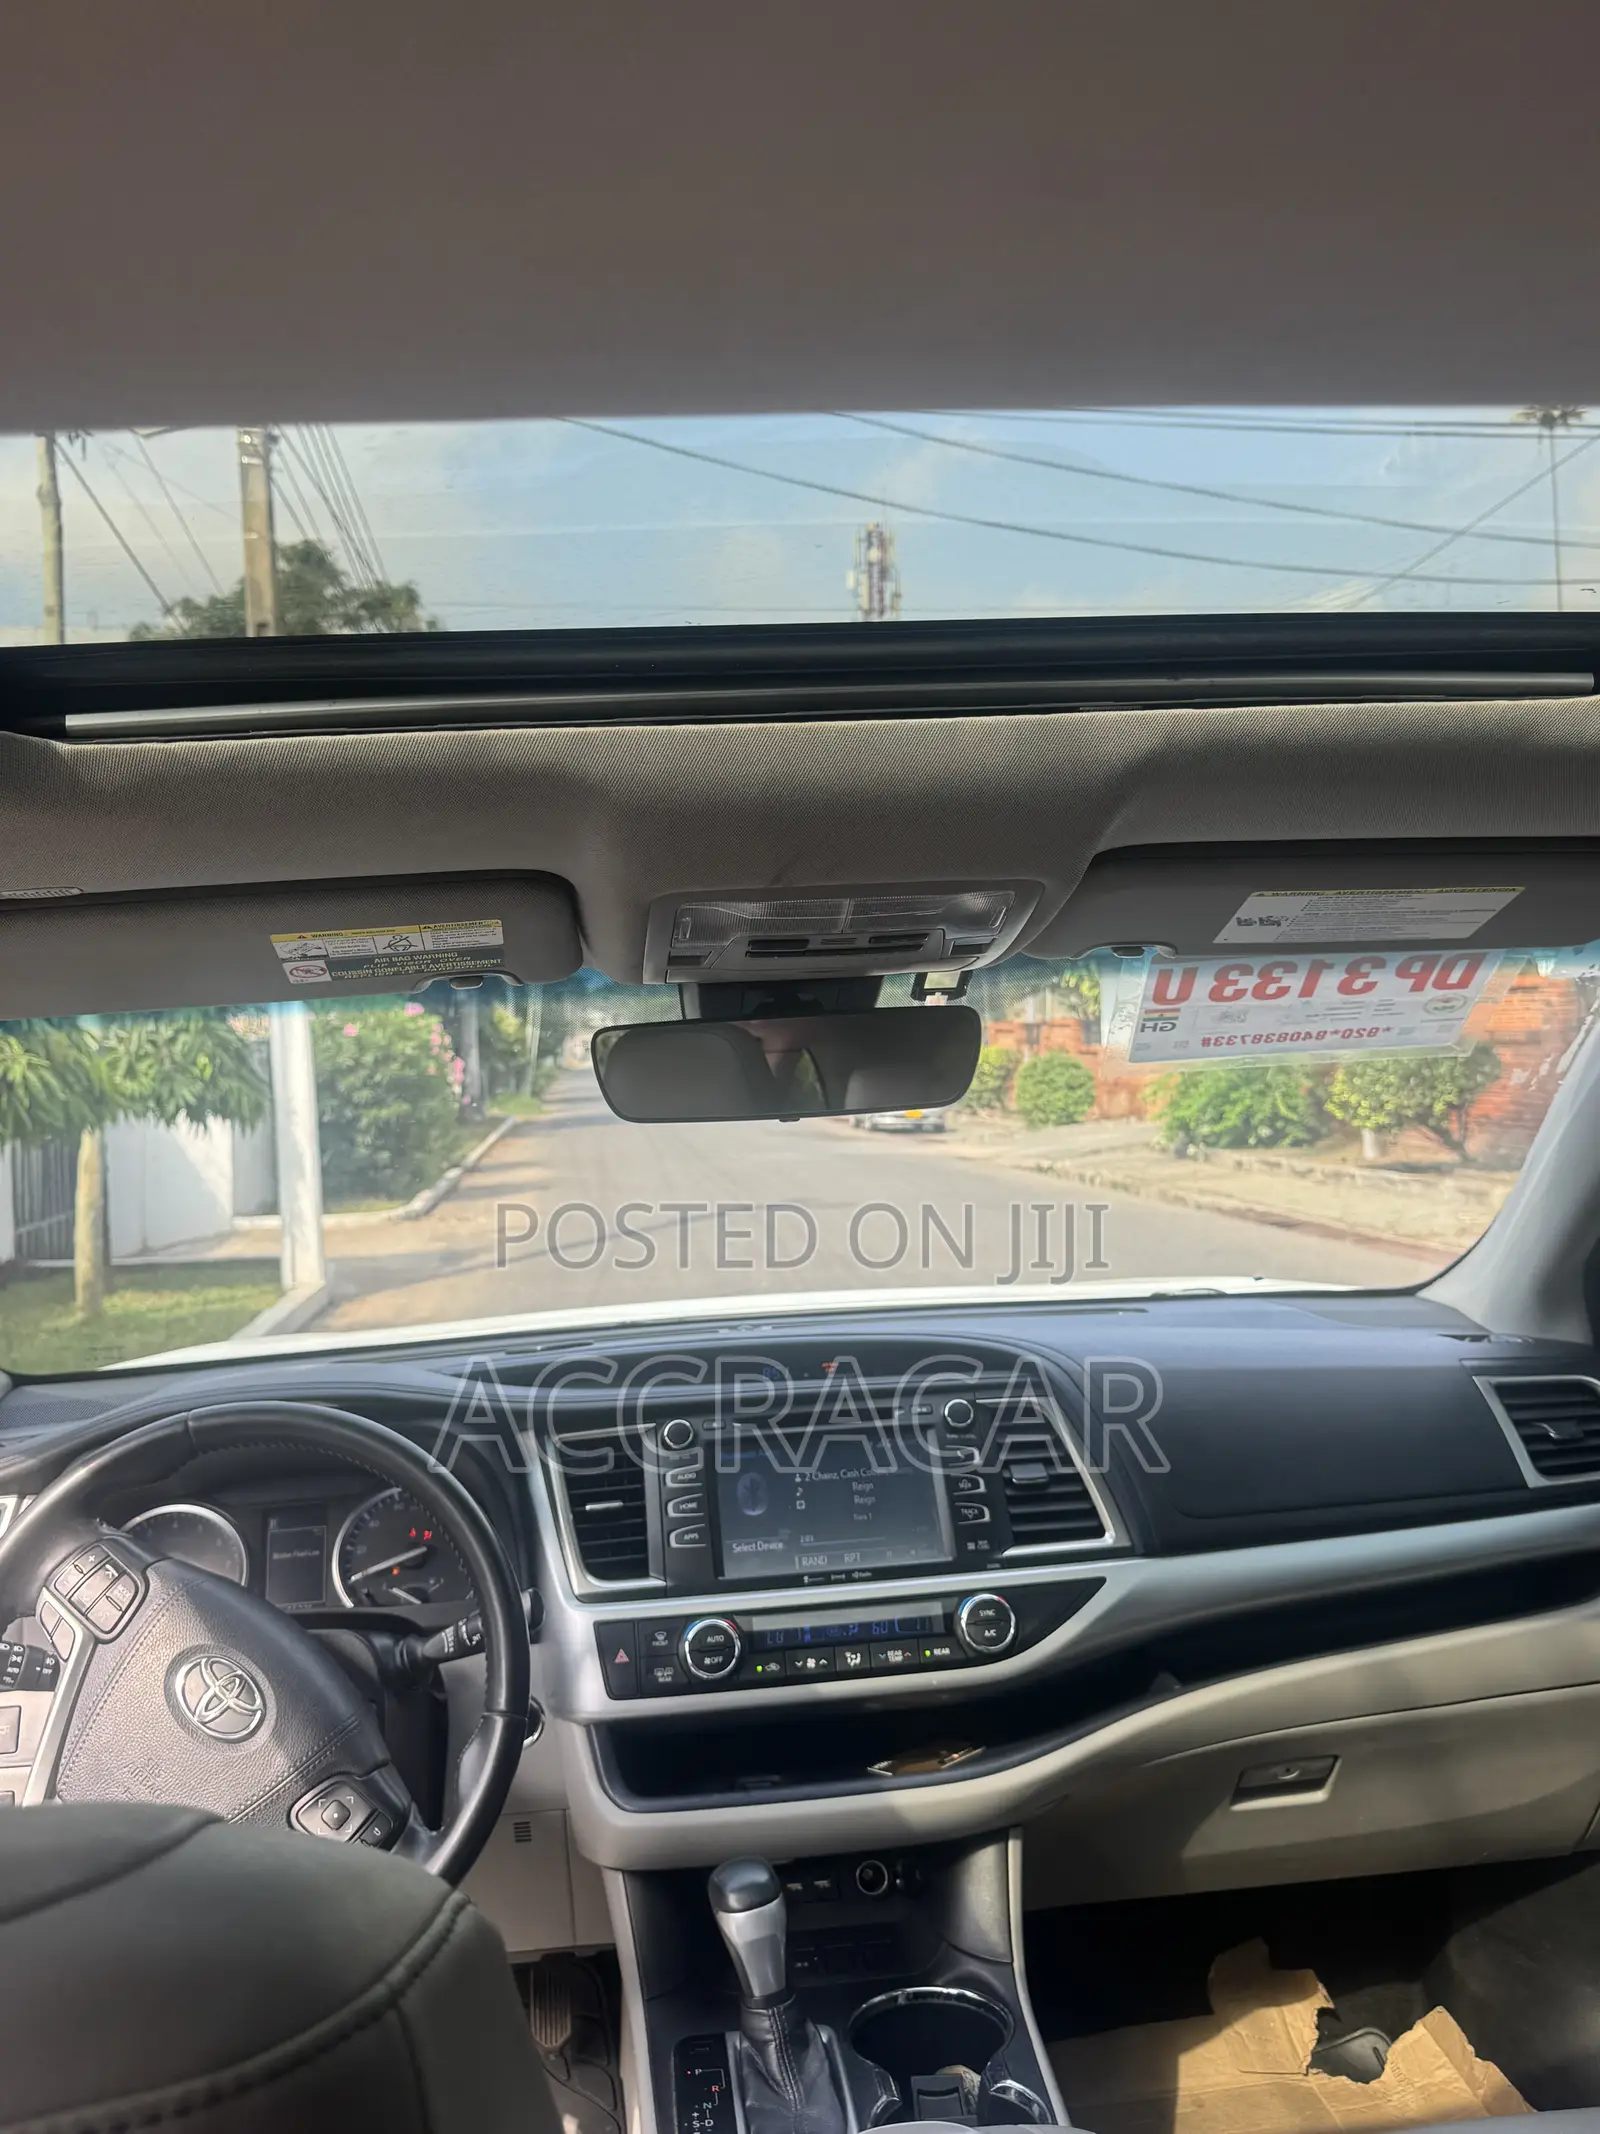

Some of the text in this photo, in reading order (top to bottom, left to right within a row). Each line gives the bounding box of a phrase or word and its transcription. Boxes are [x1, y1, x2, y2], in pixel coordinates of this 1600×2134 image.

[413, 951, 458, 961] WARNING
[331, 968, 373, 977] COUSSIN
[677, 1472, 697, 1480] AUDIO
[852, 1481, 874, 1492] Reign
[854, 1495, 876, 1506] Reign
[679, 1502, 698, 1510] HOME
[683, 1532, 699, 1540] APPS
[732, 1540, 784, 1553] Select Device
[802, 1552, 861, 1567] RAND RPT
[979, 1609, 996, 1617] SYNC
[984, 1629, 997, 1637] A/C
[707, 1635, 725, 1643] AUTO
[933, 1647, 951, 1656] REAR
[710, 1656, 724, 1664] OFF
[702, 2101, 712, 2110] N
